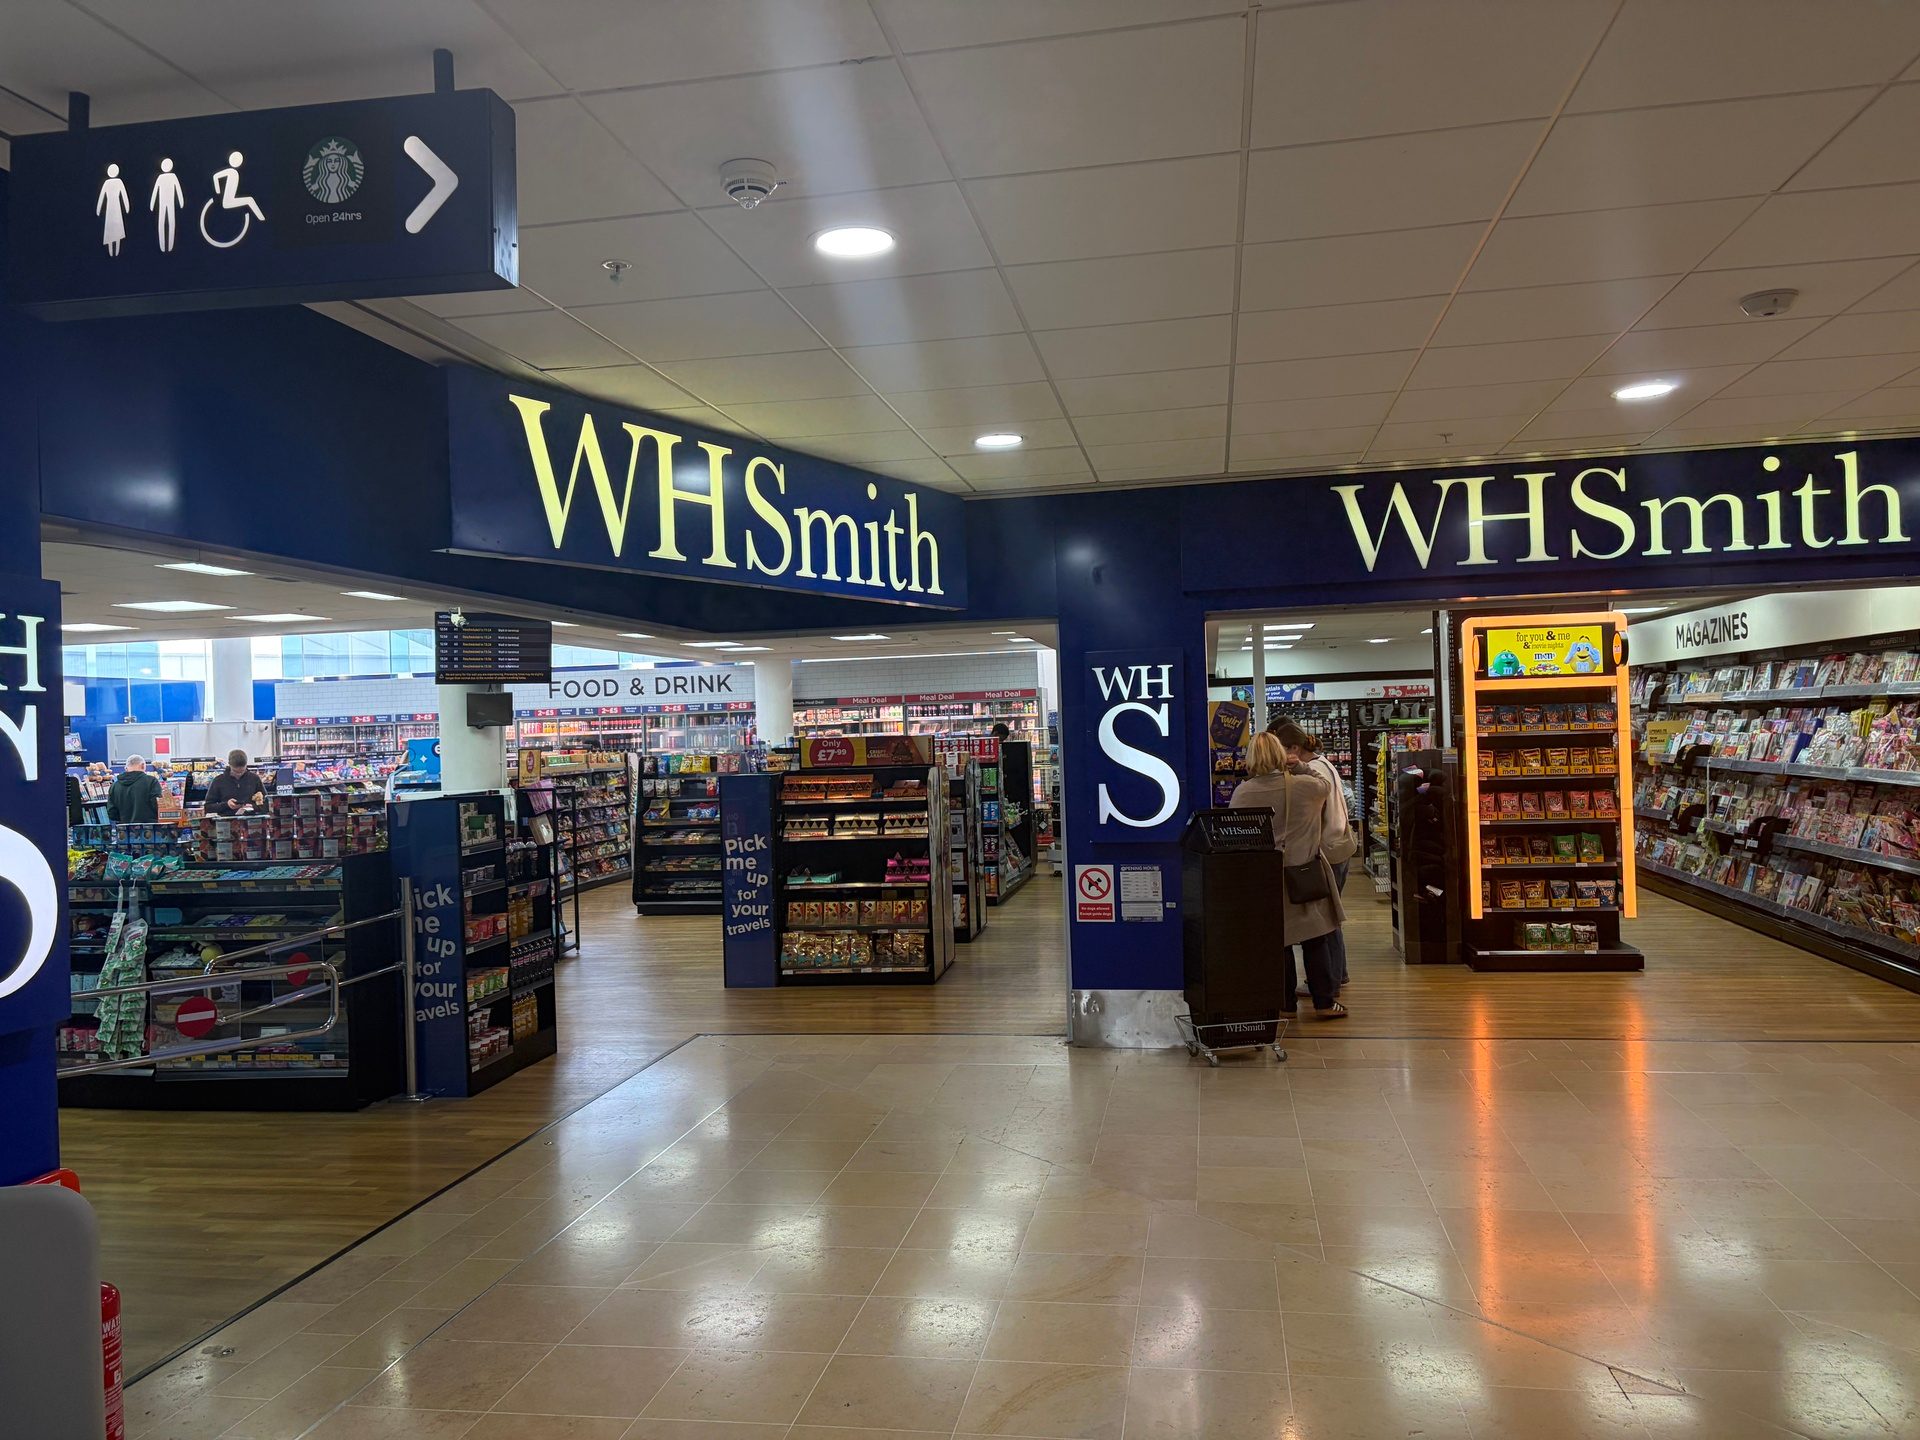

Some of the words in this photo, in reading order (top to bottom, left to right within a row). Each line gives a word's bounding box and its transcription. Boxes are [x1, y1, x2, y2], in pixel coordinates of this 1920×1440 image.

[306, 214, 330, 225] Open
[332, 212, 362, 222] 24hrs
[508, 394, 944, 595] WHSmith
[1330, 451, 1910, 573] WHSmith
[1516, 632, 1528, 642] for
[1530, 634, 1545, 644] you
[1546, 630, 1556, 641] &
[1558, 632, 1571, 640] me
[1675, 611, 1749, 649] MAGAZINES
[548, 678, 619, 699] FOOD
[629, 678, 645, 696] &
[655, 674, 733, 695] DRINK
[1091, 664, 1175, 701] WH
[1004, 690, 1020, 698] Deal
[1218, 713, 1242, 728] Twirl
[822, 740, 842, 748] Only
[1097, 702, 1181, 828] S
[1219, 826, 1262, 836] WHSmith
[724, 833, 768, 856] Pick
[726, 856, 757, 870] me
[746, 872, 769, 887] up
[414, 884, 454, 910] ick
[738, 889, 758, 901] for
[732, 904, 769, 918] your
[727, 918, 771, 936] travels
[426, 937, 456, 958] up
[416, 1000, 460, 1022] avels
[1226, 1022, 1266, 1033] WHSmith
